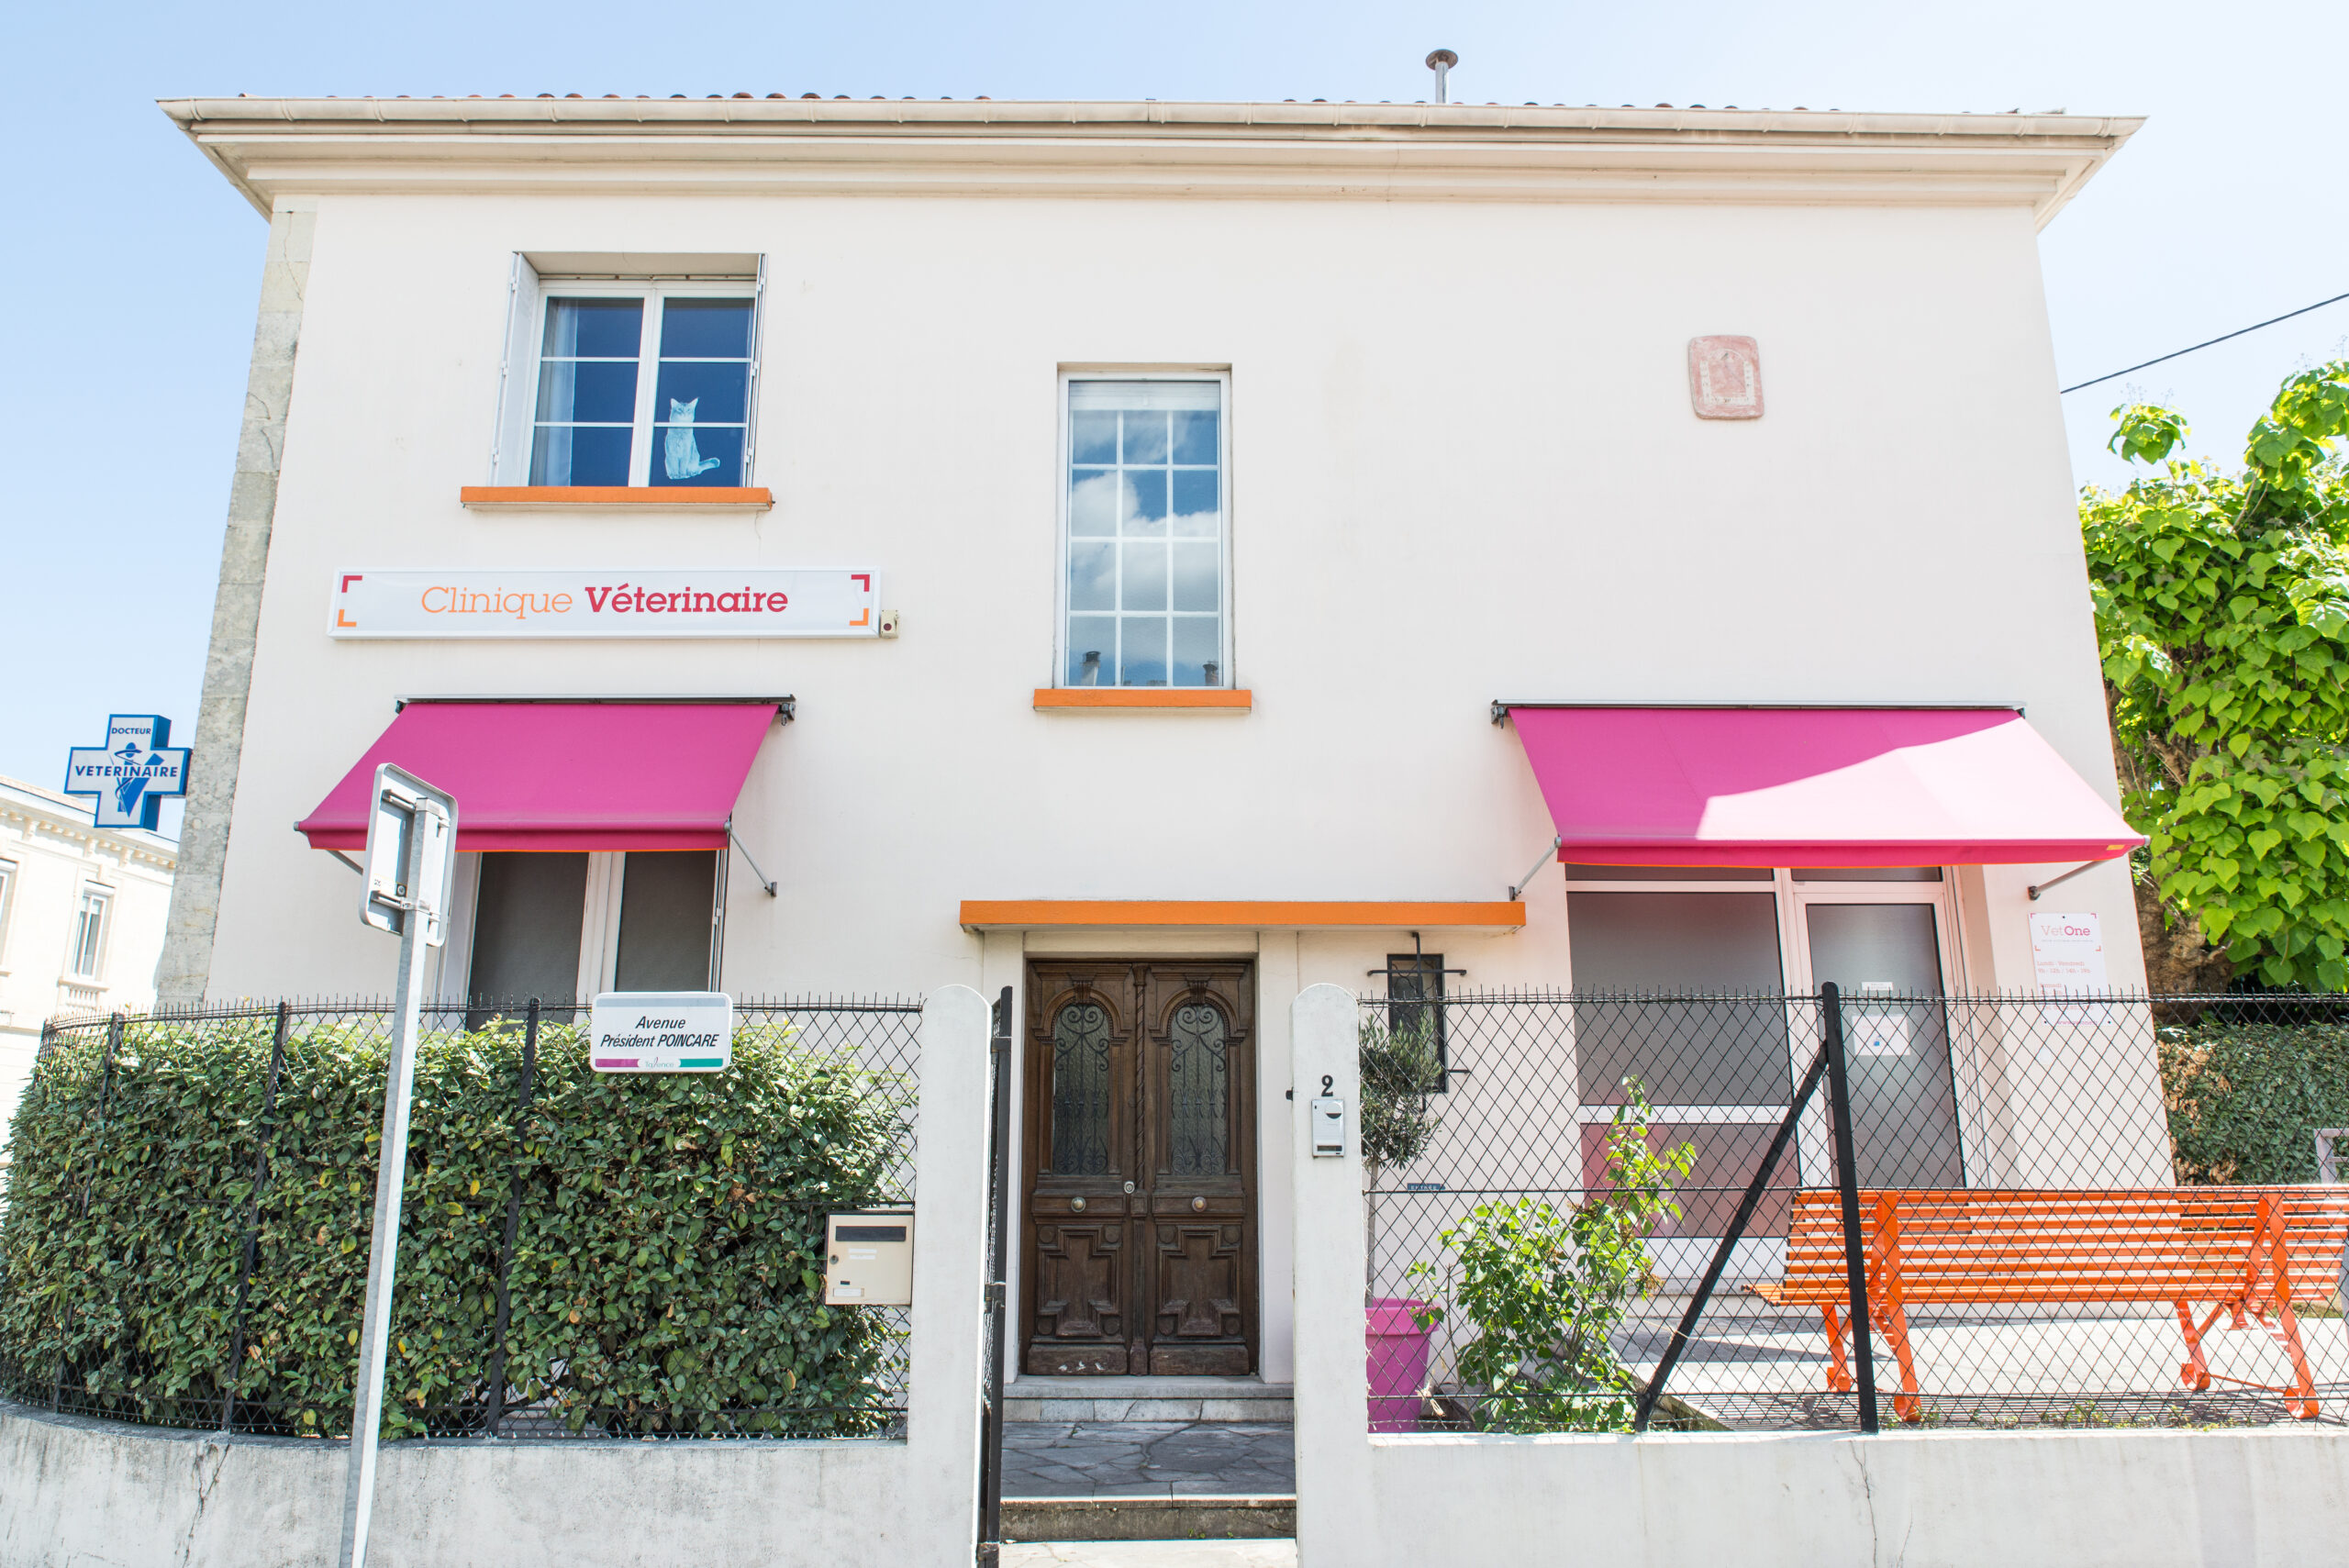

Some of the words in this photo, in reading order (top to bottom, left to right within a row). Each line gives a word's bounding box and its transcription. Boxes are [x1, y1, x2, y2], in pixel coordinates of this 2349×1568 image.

[421, 585, 573, 620] Clinique
[584, 583, 788, 613] Véterinaire
[111, 727, 151, 735] DOCTEUR
[75, 765, 179, 777] VETERINAIRE
[2040, 925, 2091, 936] VetOne
[635, 1016, 685, 1029] Avenue
[600, 1033, 655, 1047] Président
[657, 1033, 719, 1047] POINCARE
[1320, 1074, 1333, 1096] 2
